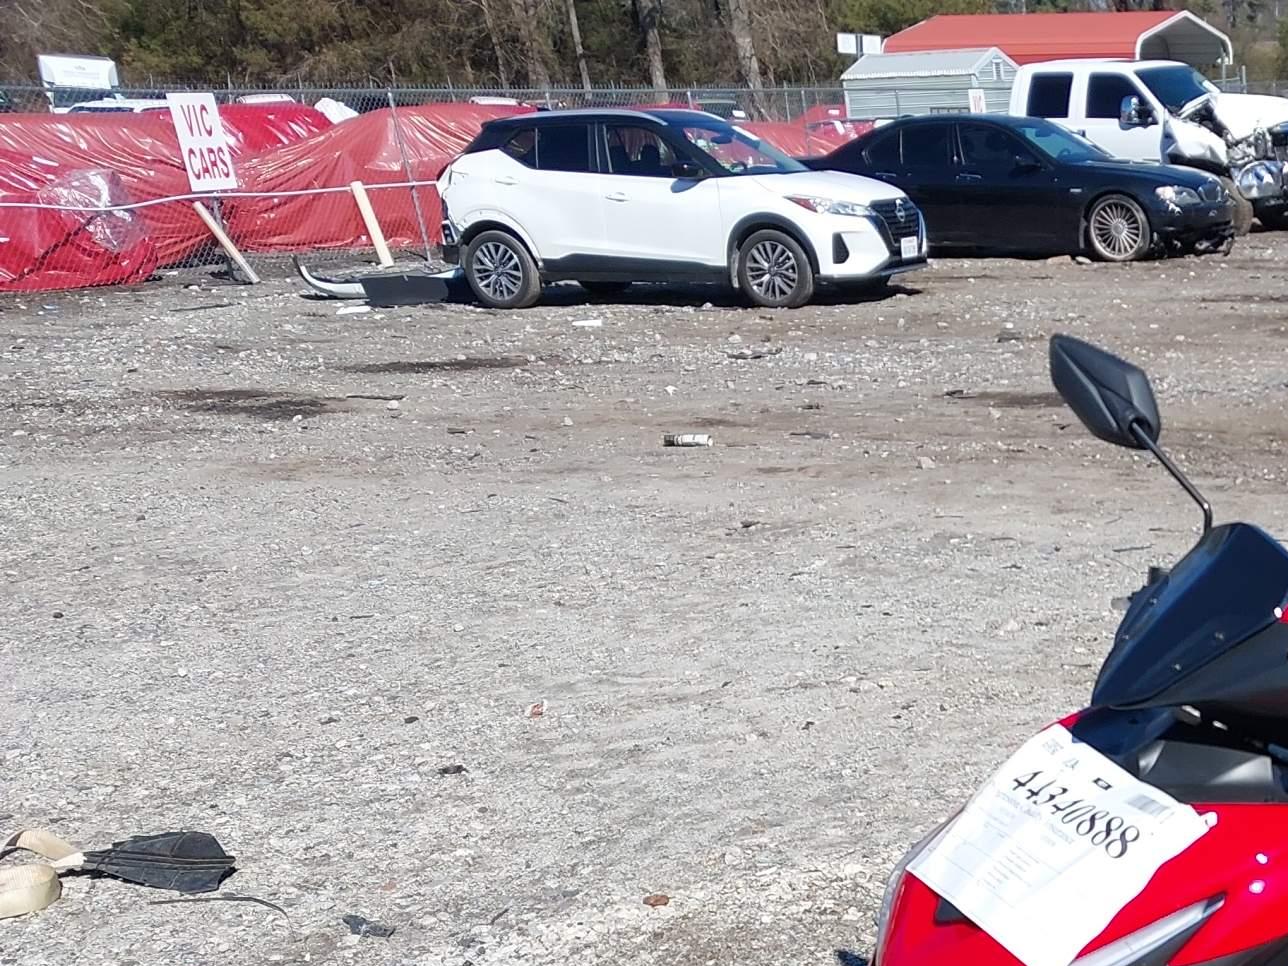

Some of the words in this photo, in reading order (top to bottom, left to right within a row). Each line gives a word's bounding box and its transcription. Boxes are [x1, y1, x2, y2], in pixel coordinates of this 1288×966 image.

[180, 104, 213, 137] VIC
[187, 146, 231, 180] CARS
[1012, 770, 1140, 859] 44340888
